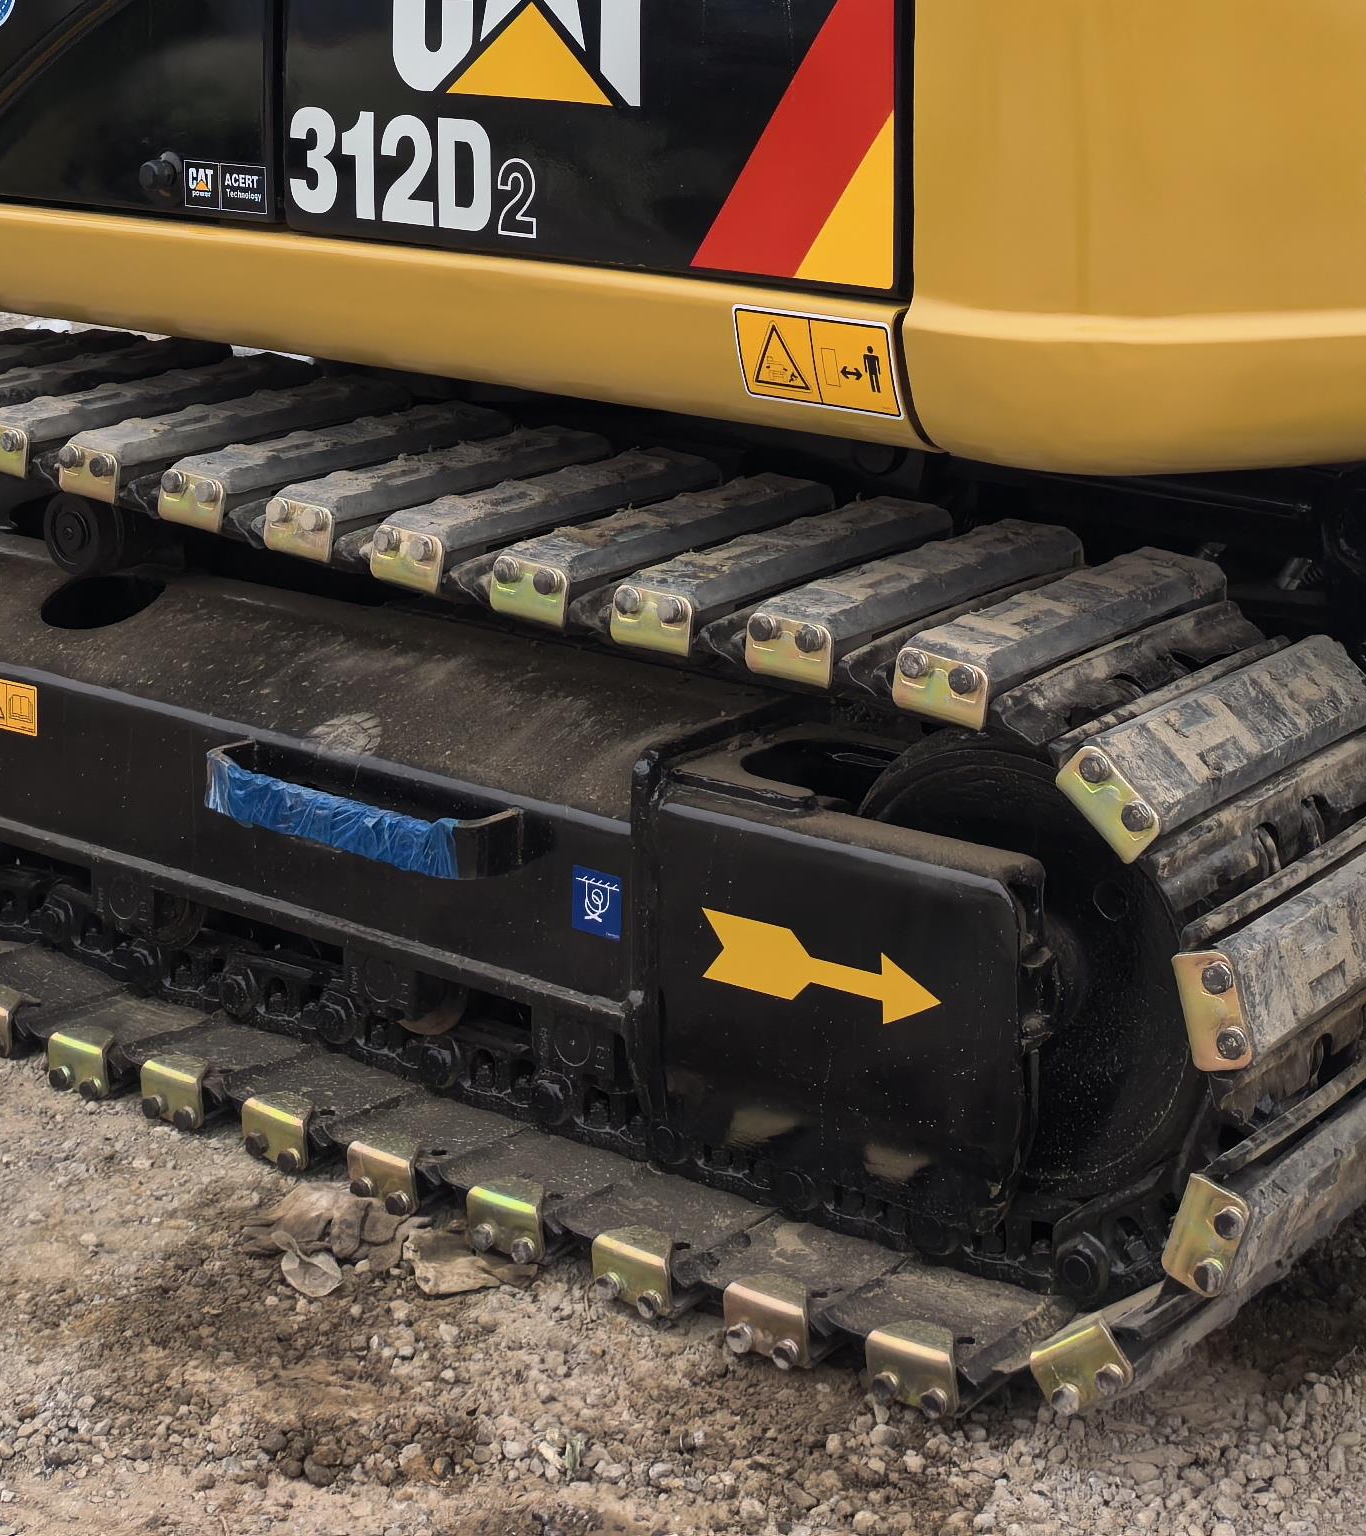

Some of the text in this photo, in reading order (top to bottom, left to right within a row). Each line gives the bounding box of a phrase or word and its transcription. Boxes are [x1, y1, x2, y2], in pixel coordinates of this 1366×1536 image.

[189, 168, 214, 191] CAT
[225, 173, 259, 188] ACERT
[226, 189, 262, 202] Technology
